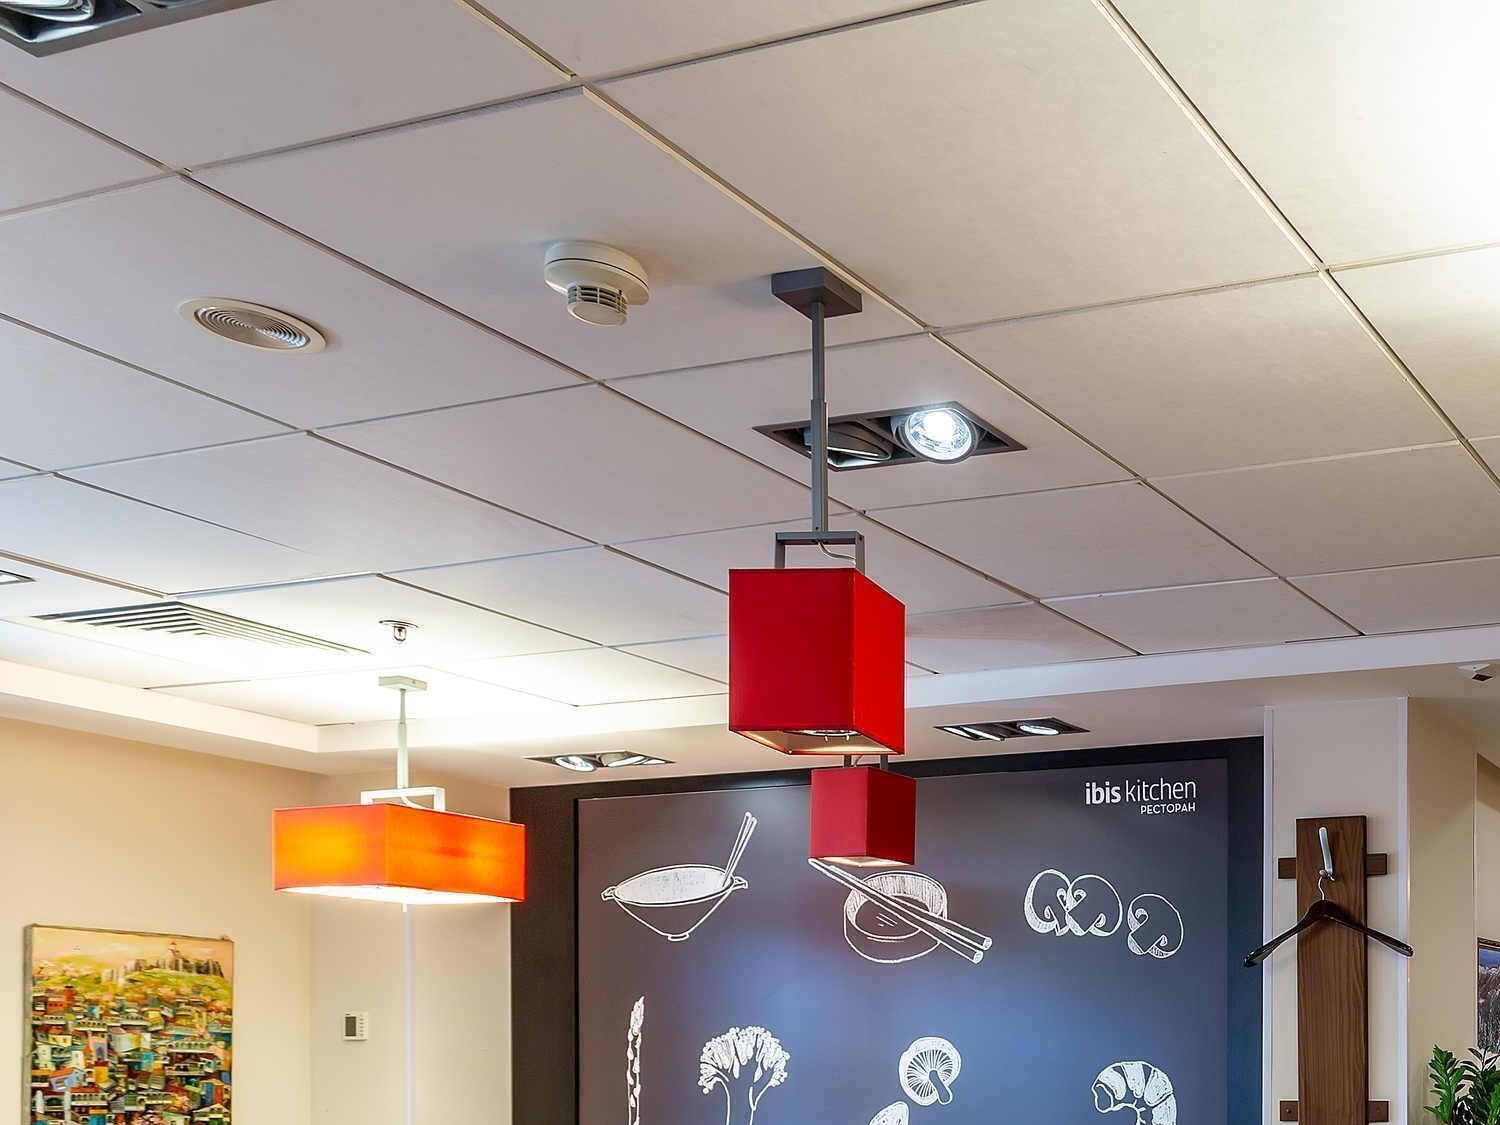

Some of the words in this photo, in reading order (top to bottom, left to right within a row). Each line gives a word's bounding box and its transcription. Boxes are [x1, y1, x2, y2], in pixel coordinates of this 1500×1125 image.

[1085, 782, 1121, 805] ibis
[1125, 778, 1196, 802] kitchen
[1140, 802, 1196, 815] РЕСТОРАН
